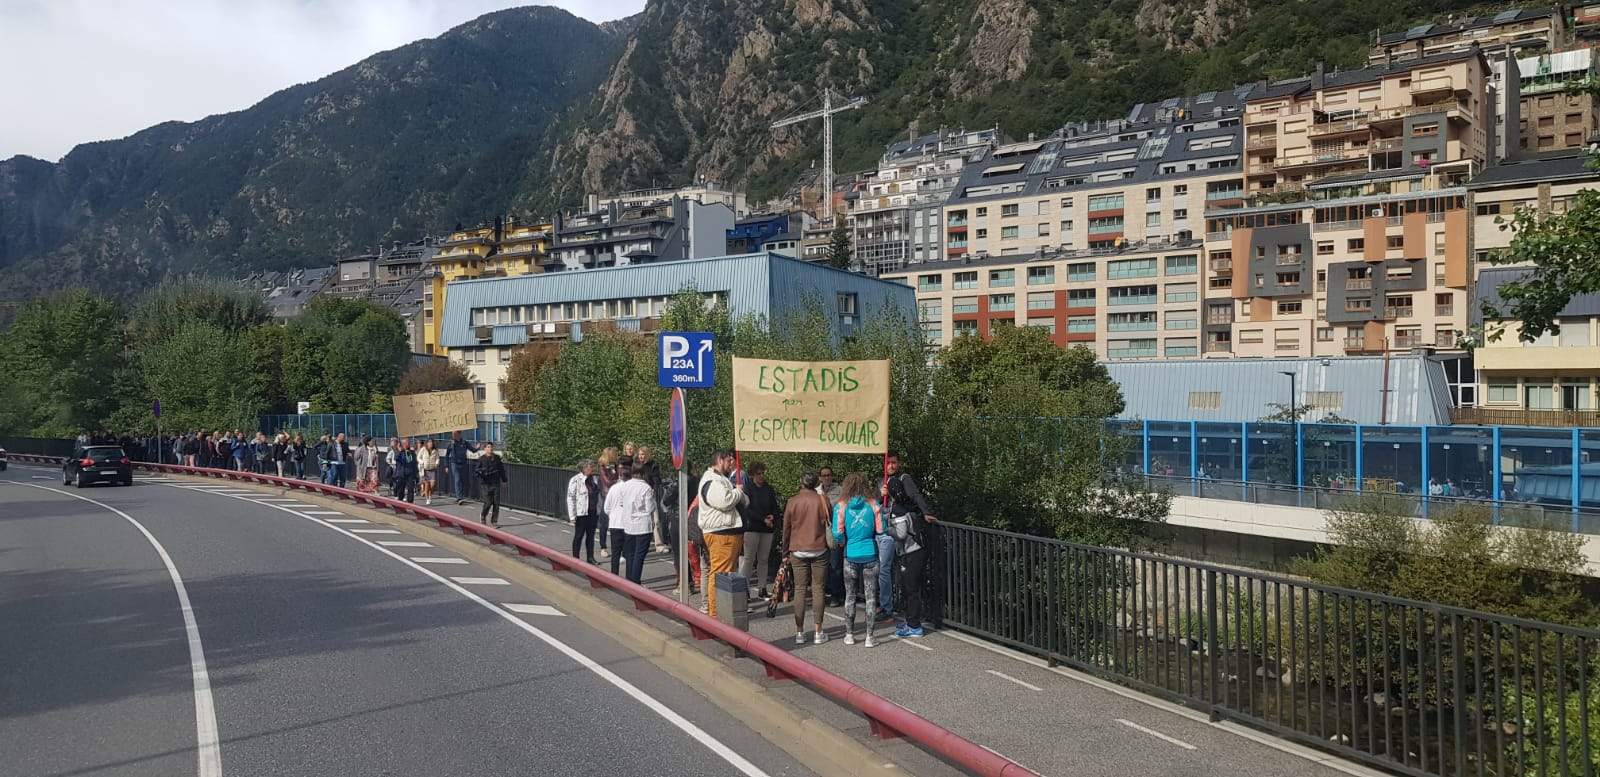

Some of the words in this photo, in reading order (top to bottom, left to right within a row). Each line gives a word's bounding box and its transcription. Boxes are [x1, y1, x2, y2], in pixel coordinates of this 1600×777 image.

[663, 336, 689, 368] P
[672, 359, 694, 369] 23A
[672, 374, 698, 383] 360m.
[818, 400, 826, 408] a
[819, 420, 880, 448] ESCOLAR
